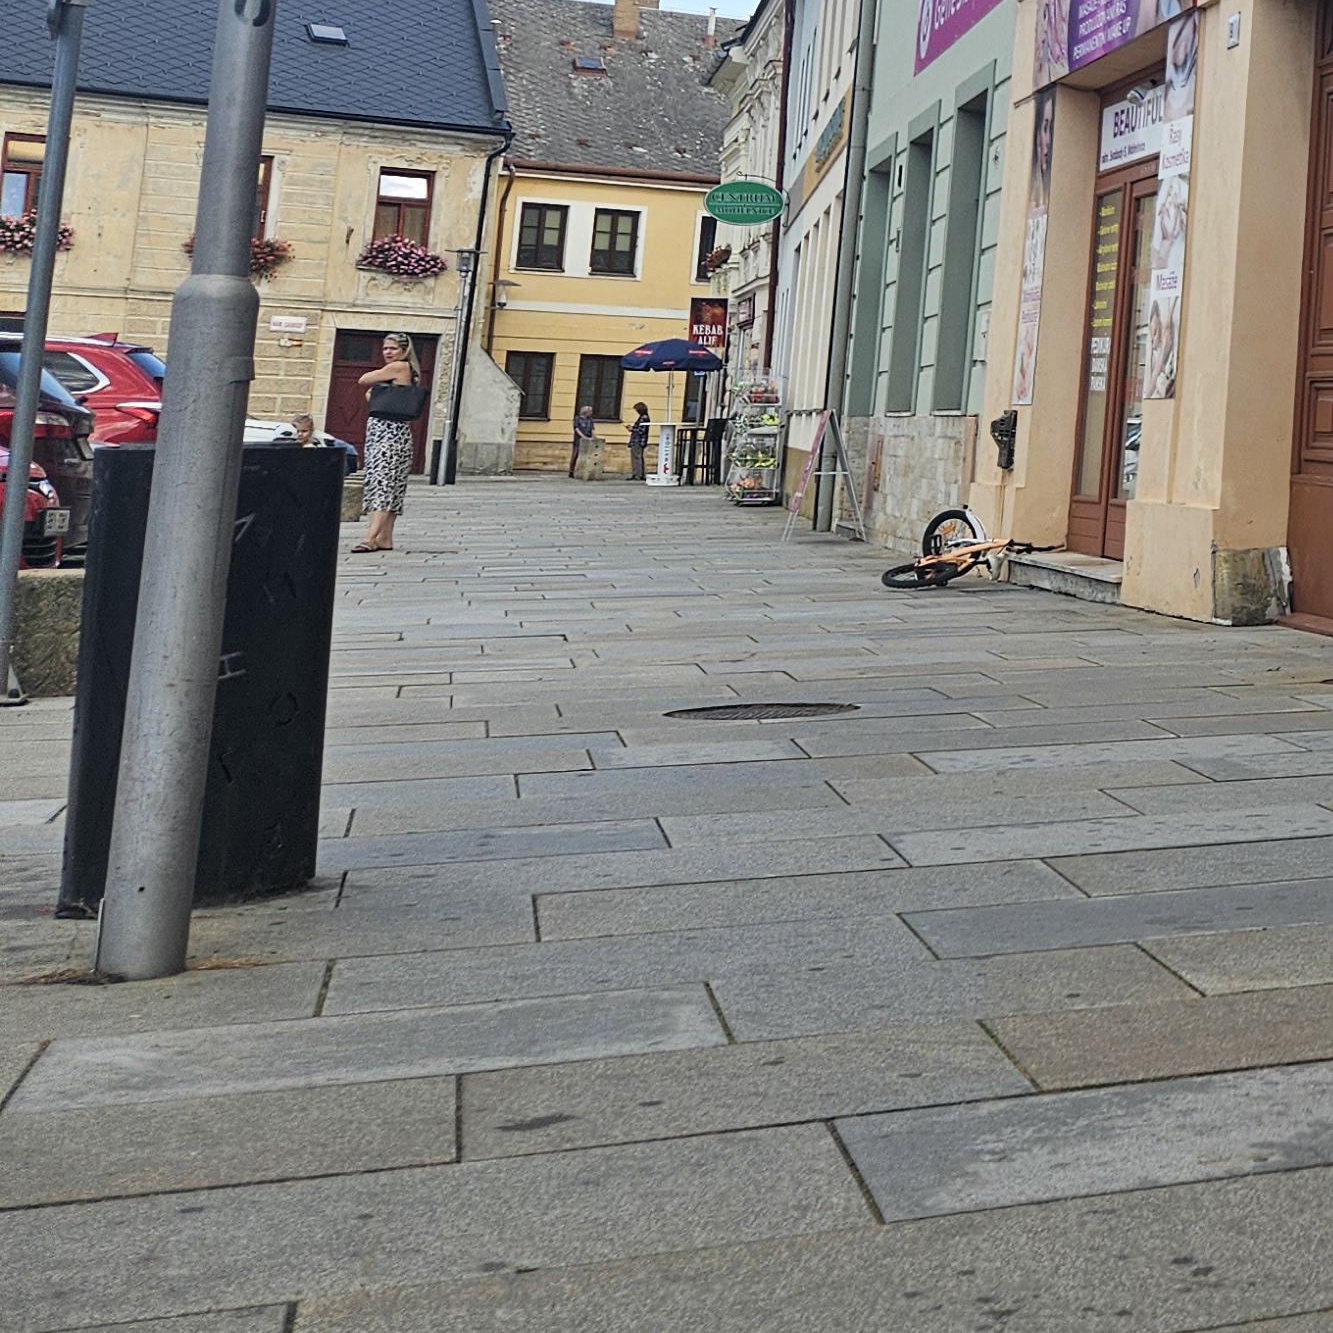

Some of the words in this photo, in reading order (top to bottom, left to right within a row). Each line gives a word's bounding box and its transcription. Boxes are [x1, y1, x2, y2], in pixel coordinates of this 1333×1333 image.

[1113, 94, 1163, 139] BEAUTIFUL
[711, 192, 776, 203] CENTRUM
[692, 324, 724, 336] KEBAB
